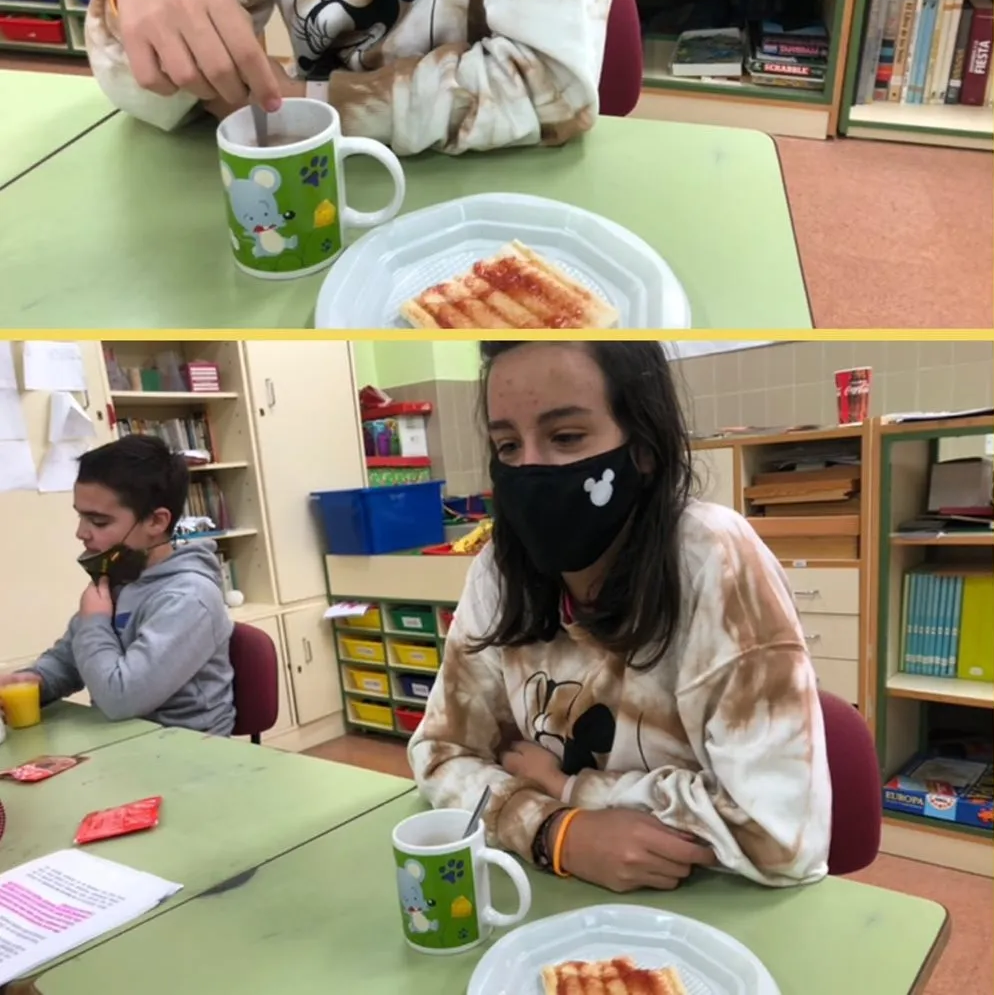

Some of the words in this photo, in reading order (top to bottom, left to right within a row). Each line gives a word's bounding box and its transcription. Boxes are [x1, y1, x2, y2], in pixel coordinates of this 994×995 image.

[973, 40, 992, 75] FIESTA
[763, 62, 811, 76] SCRABBLE
[884, 790, 925, 806] EUROPA
